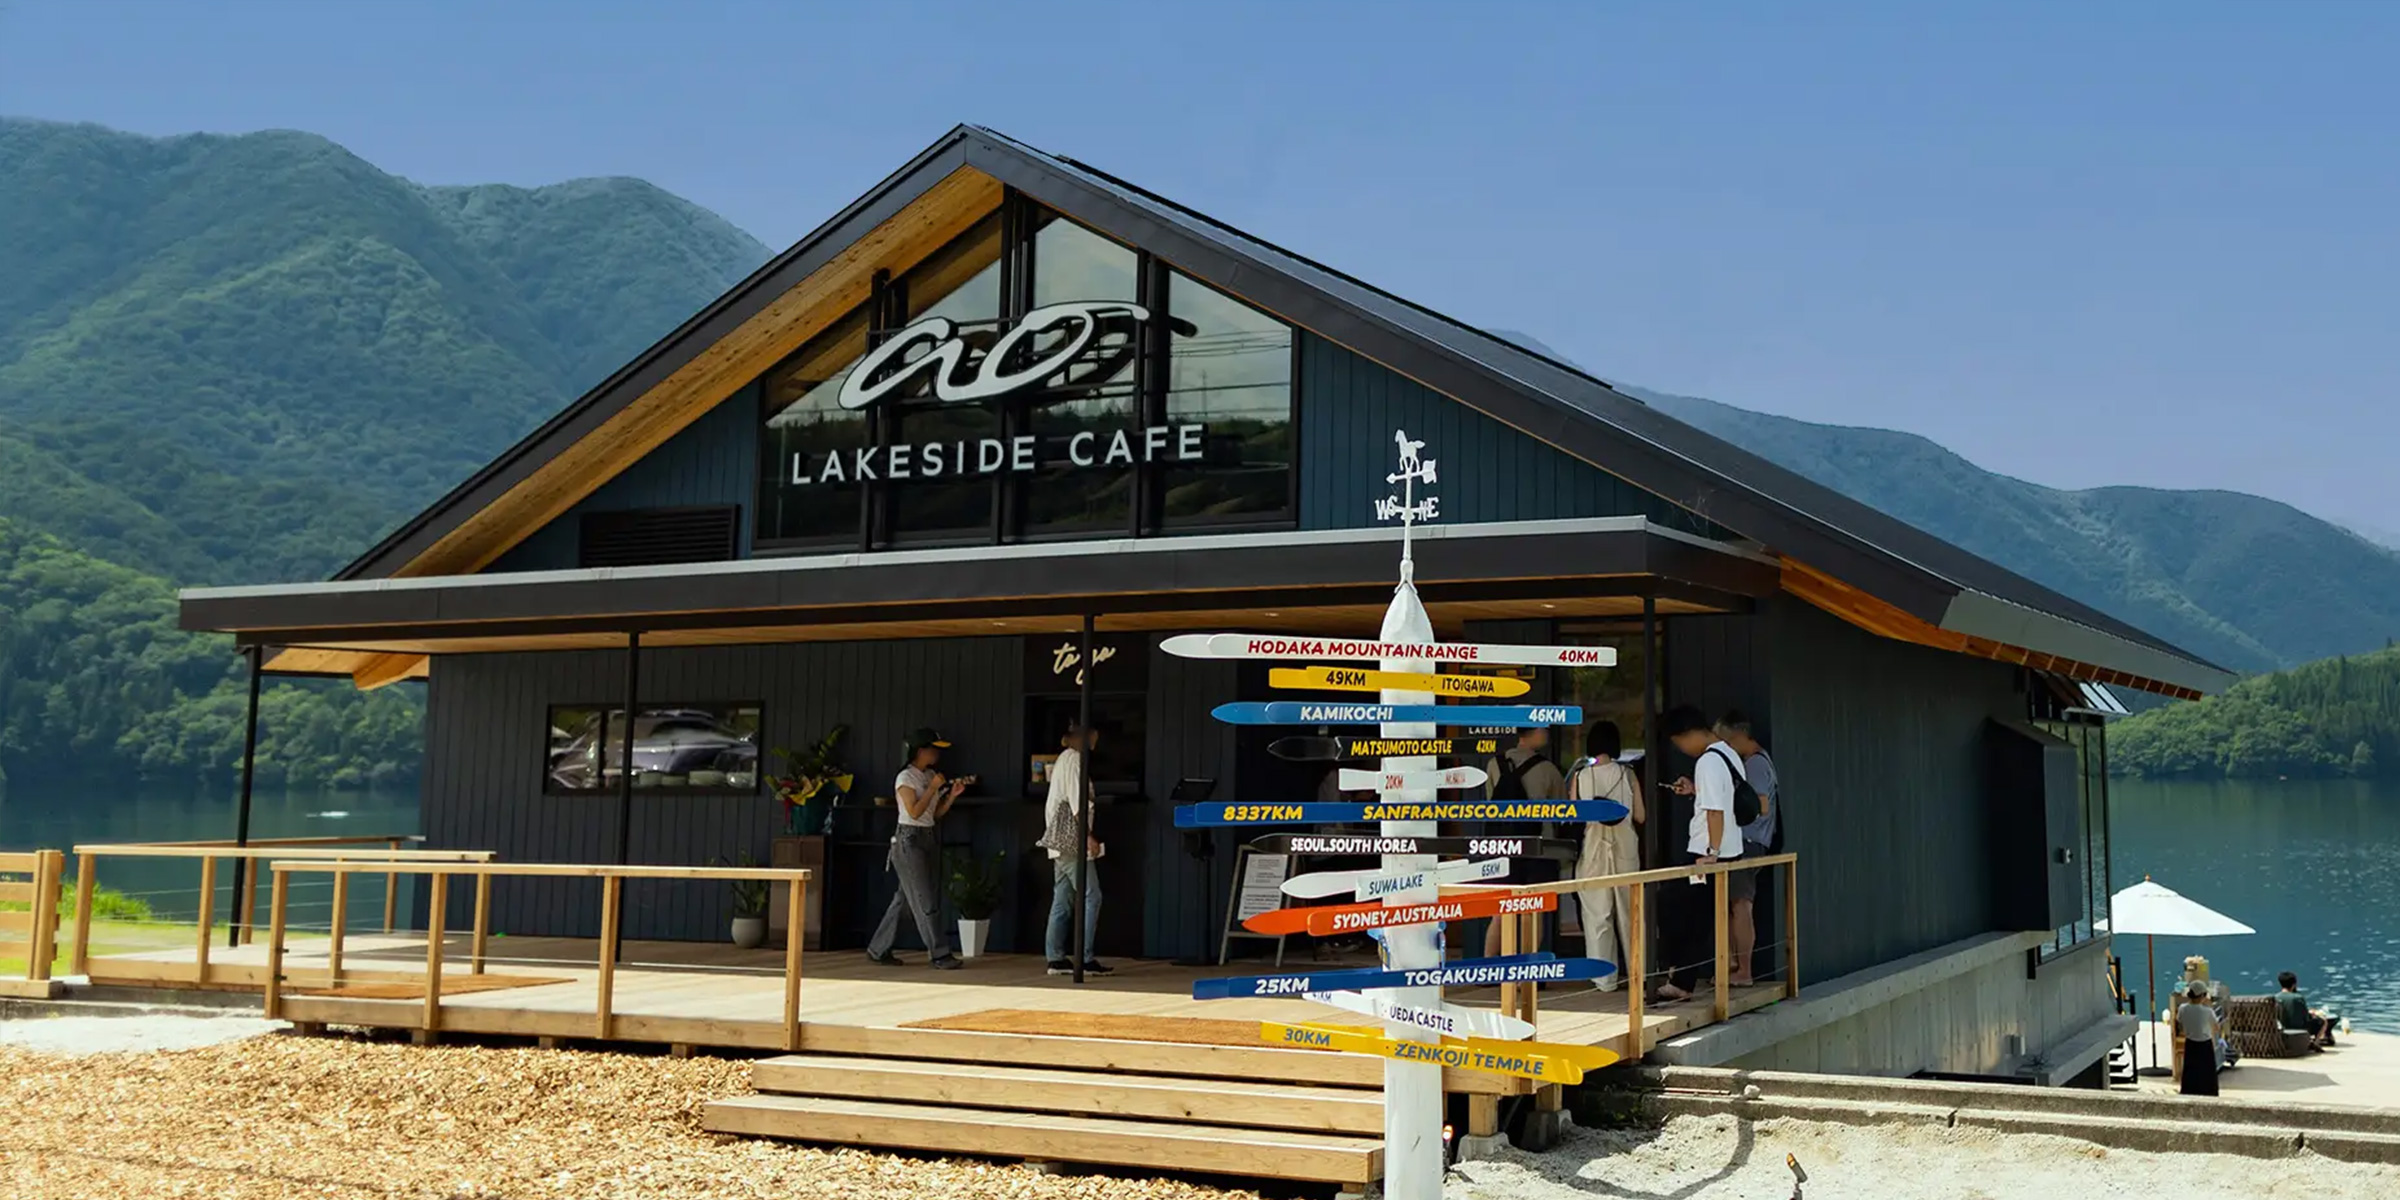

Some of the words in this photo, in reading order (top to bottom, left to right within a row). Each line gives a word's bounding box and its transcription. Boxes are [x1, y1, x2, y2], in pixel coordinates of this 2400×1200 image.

[792, 435, 1036, 485] LAKESIDE
[1068, 424, 1205, 467] CAFE
[1247, 640, 1324, 656] HODAKA
[1328, 642, 1422, 659] MOUNTAIN
[1425, 644, 1478, 660] RANGE
[1558, 649, 1598, 663] 40KM
[1325, 670, 1366, 687] 49KM
[1441, 677, 1495, 694] ITOIGAWA
[1300, 705, 1393, 722] KAMIKOCHI
[1528, 707, 1566, 723] 46KM
[1468, 726, 1518, 735] LAKESIDE
[1351, 740, 1419, 756] MATSUMOTO
[1420, 740, 1452, 755] CASTLE
[1476, 739, 1497, 754] 42KM
[1223, 805, 1303, 821] 8337KM
[1362, 804, 1578, 821] SANFRANCISCO.AMERICA
[1374, 838, 1418, 854] KOREA
[1468, 839, 1523, 855] 968KM
[1368, 879, 1399, 895] SUWA
[1399, 874, 1423, 890] LAKE
[1498, 896, 1544, 914] 7956KM
[1333, 903, 1463, 930] SYDNEY.AUSTRALIA
[1404, 965, 1506, 986] TOGAKUSHI
[1508, 963, 1566, 981] SHRINE
[1255, 977, 1310, 995] 25KM
[1389, 1005, 1415, 1024] UEDA
[1416, 1012, 1454, 1032] CASTLE
[1284, 1027, 1331, 1047] 30KM
[1394, 1042, 1470, 1068] ZENKOJI
[1474, 1053, 1544, 1076] TEMPLE
